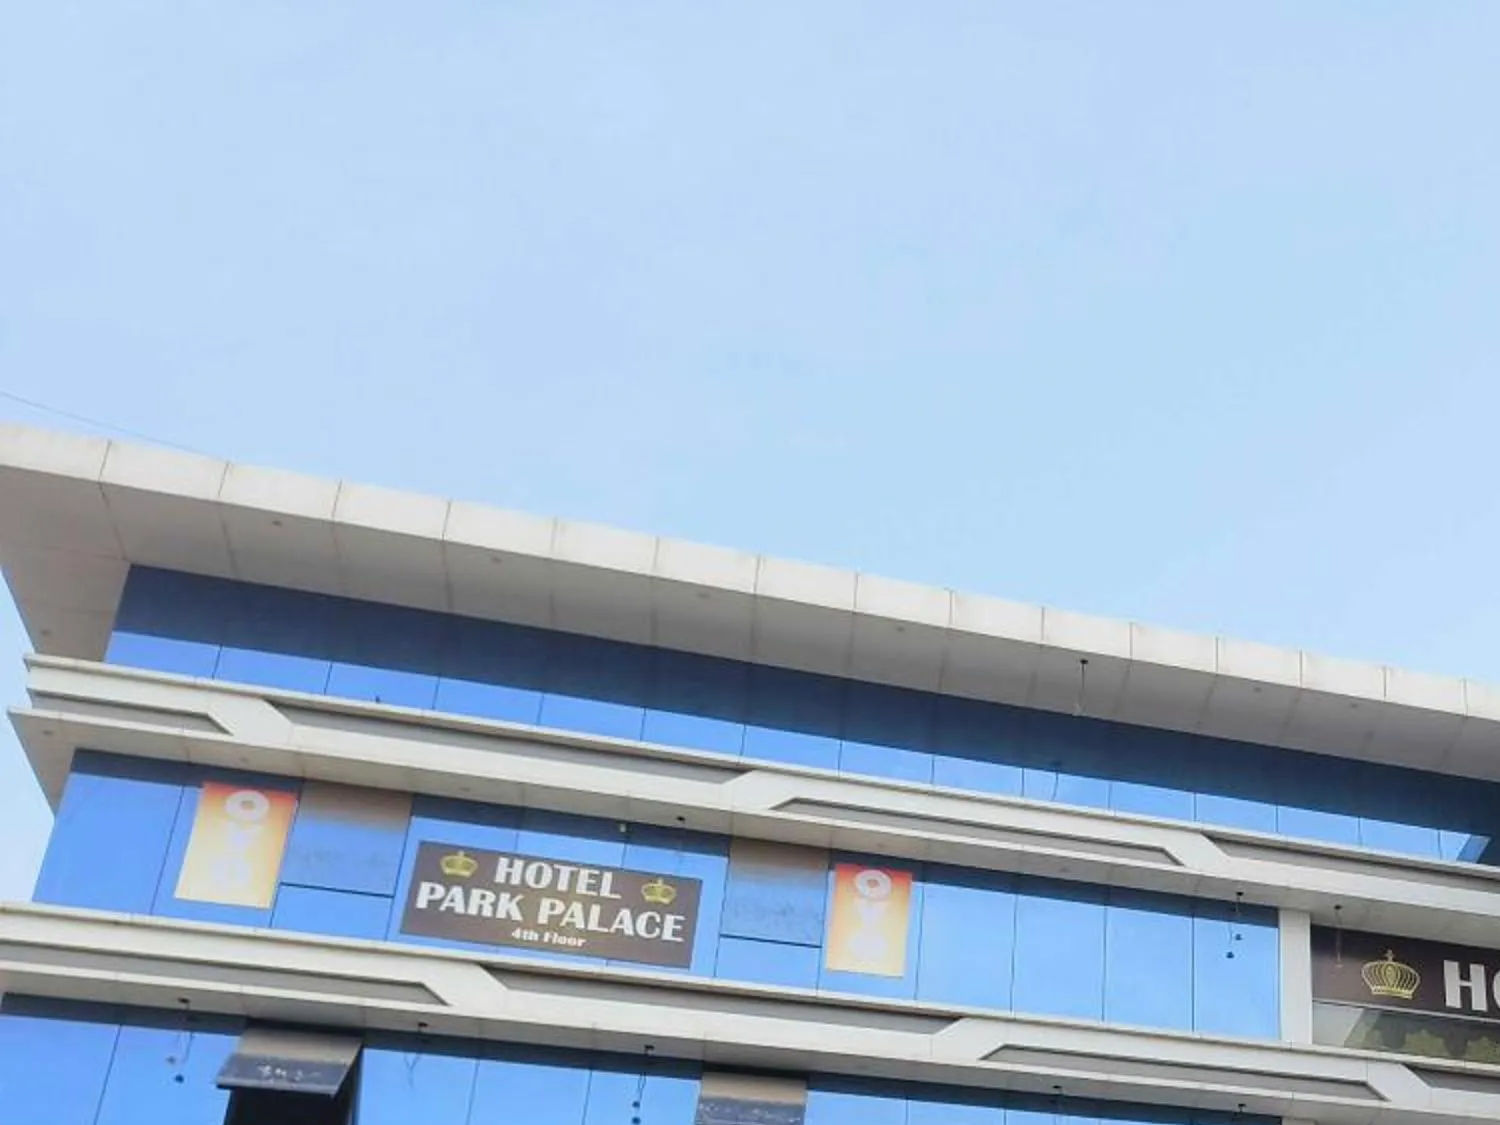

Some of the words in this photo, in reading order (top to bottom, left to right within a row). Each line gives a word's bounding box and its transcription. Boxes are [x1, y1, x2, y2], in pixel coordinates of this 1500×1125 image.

[494, 856, 622, 900] HOTEL
[415, 881, 525, 922] PARK
[536, 896, 686, 943] PALACE
[511, 927, 540, 942] 4th
[543, 930, 588, 948] Floor
